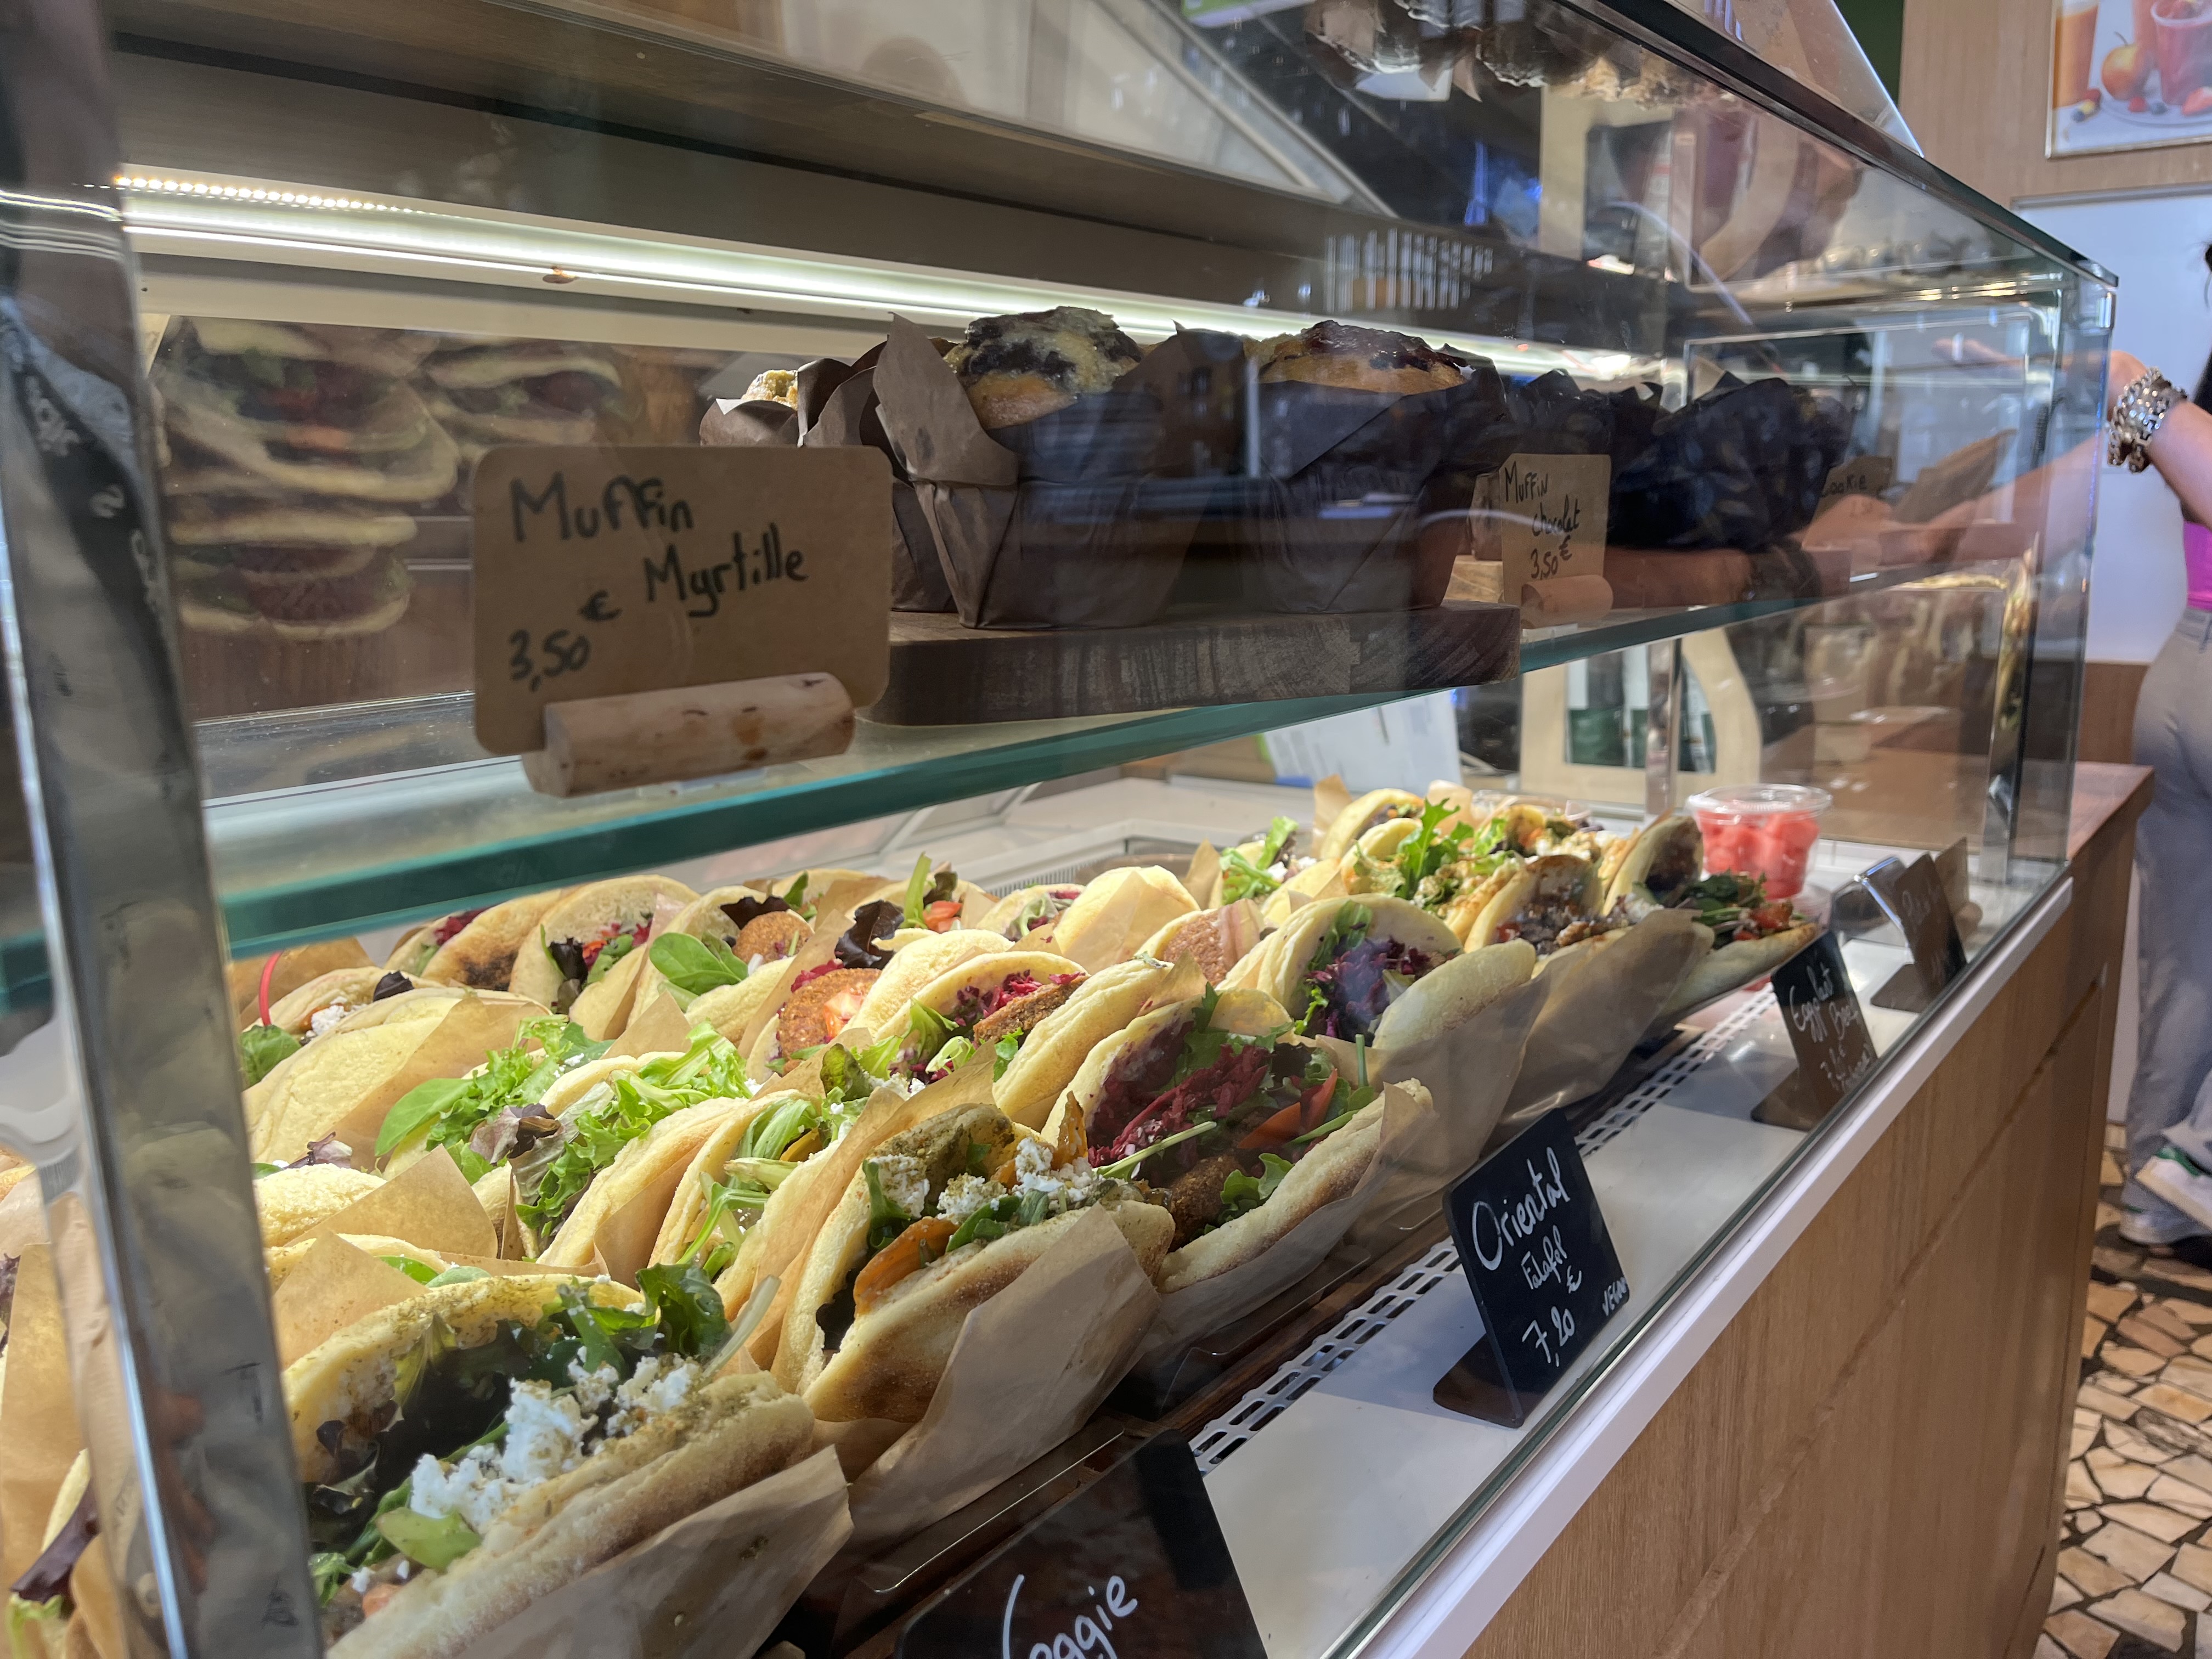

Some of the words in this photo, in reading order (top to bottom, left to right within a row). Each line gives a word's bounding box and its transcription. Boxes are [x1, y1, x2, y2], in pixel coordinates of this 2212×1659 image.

[510, 471, 694, 542] Muffin
[642, 522, 809, 617] Myrtille
[1472, 1146, 1571, 1271] Oriental
